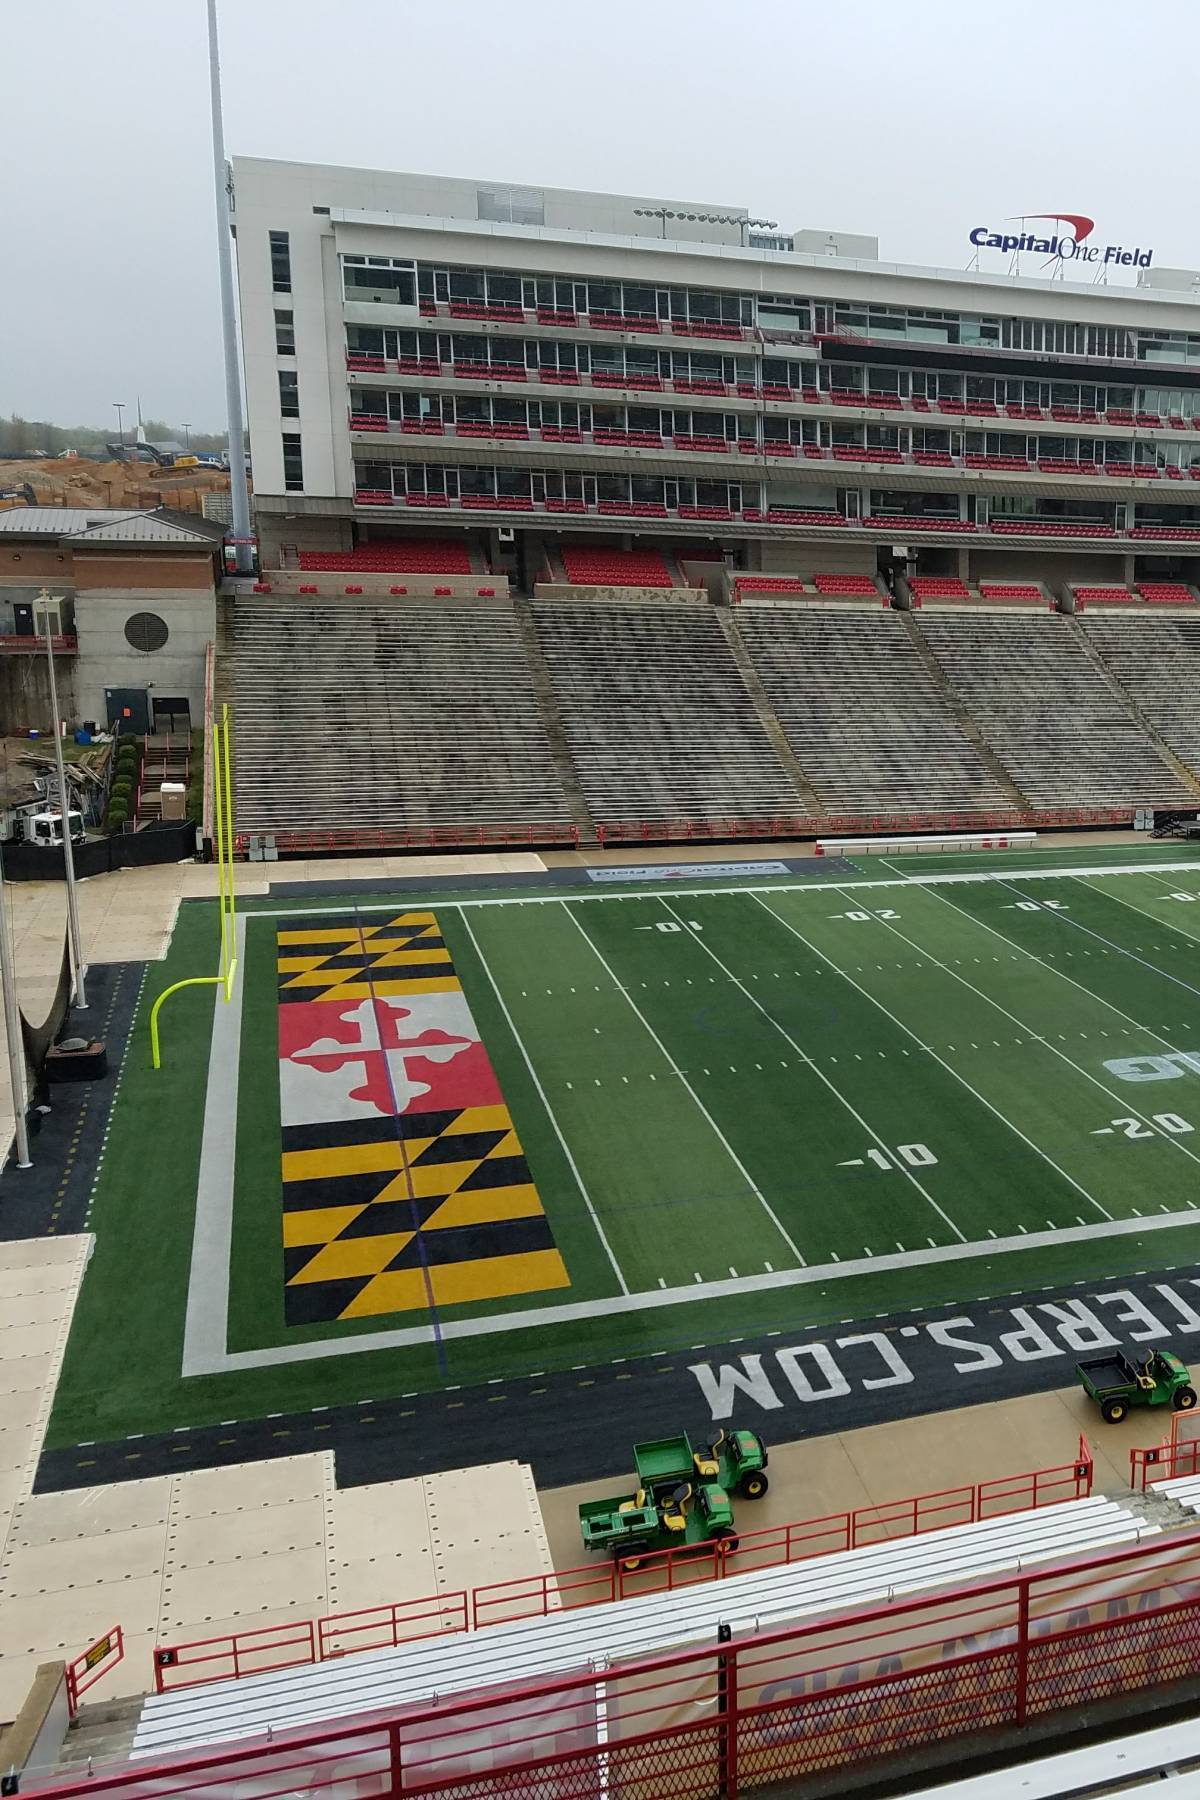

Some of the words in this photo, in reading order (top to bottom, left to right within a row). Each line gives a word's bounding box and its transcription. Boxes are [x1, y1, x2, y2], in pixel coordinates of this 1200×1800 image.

[1103, 246, 1153, 268] Field
[1014, 899, 1070, 911] 30
[844, 909, 902, 921] 20
[655, 920, 704, 932] 10
[1111, 1113, 1195, 1139] 20
[867, 1143, 939, 1170] 10
[162, 1653, 171, 1663] 2
